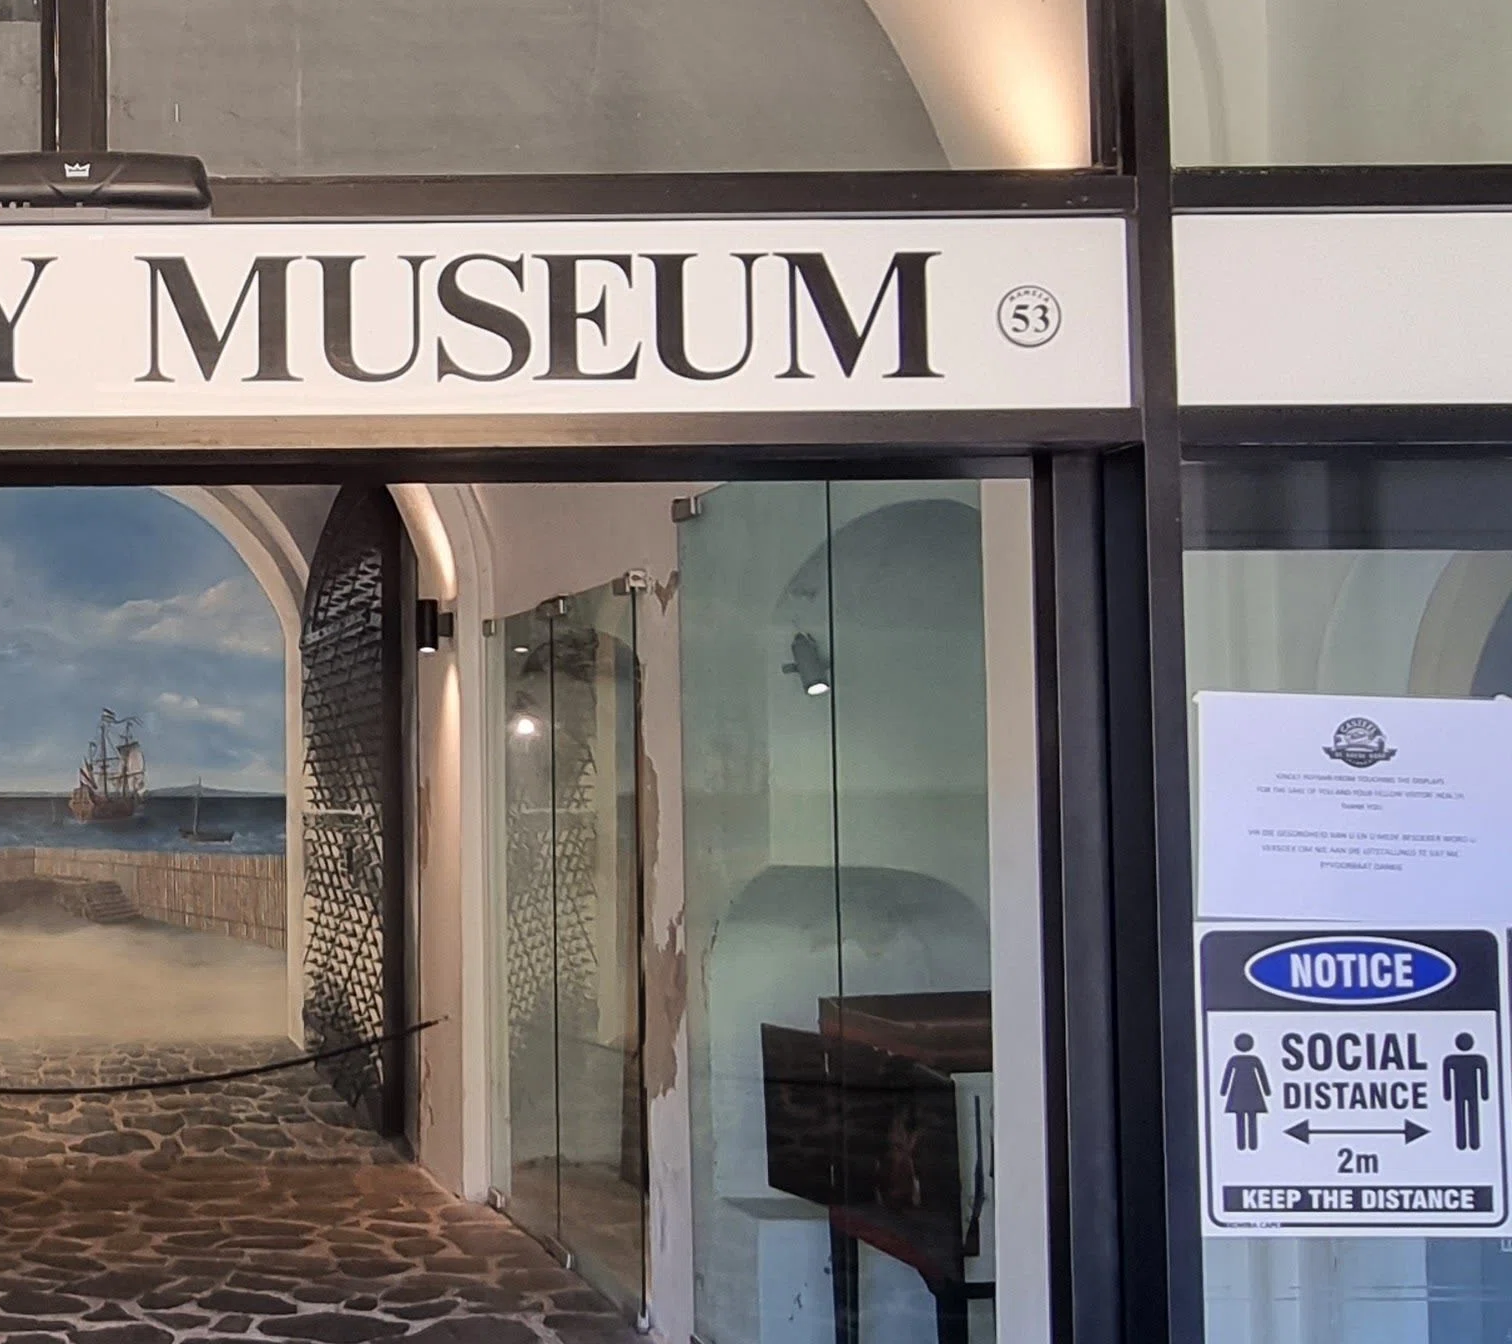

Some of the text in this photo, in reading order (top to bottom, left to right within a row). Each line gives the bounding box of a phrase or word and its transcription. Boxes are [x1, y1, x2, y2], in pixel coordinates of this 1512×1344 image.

[134, 251, 945, 383] MUSEUM
[1012, 304, 1050, 333] 53
[1290, 952, 1415, 988] NOTICE
[1281, 1032, 1428, 1072] SOCIAL
[1282, 1081, 1429, 1110] DISTANCE
[1337, 1148, 1379, 1174] 2m
[1242, 1188, 1475, 1209] KEEP THE DISTANCE
